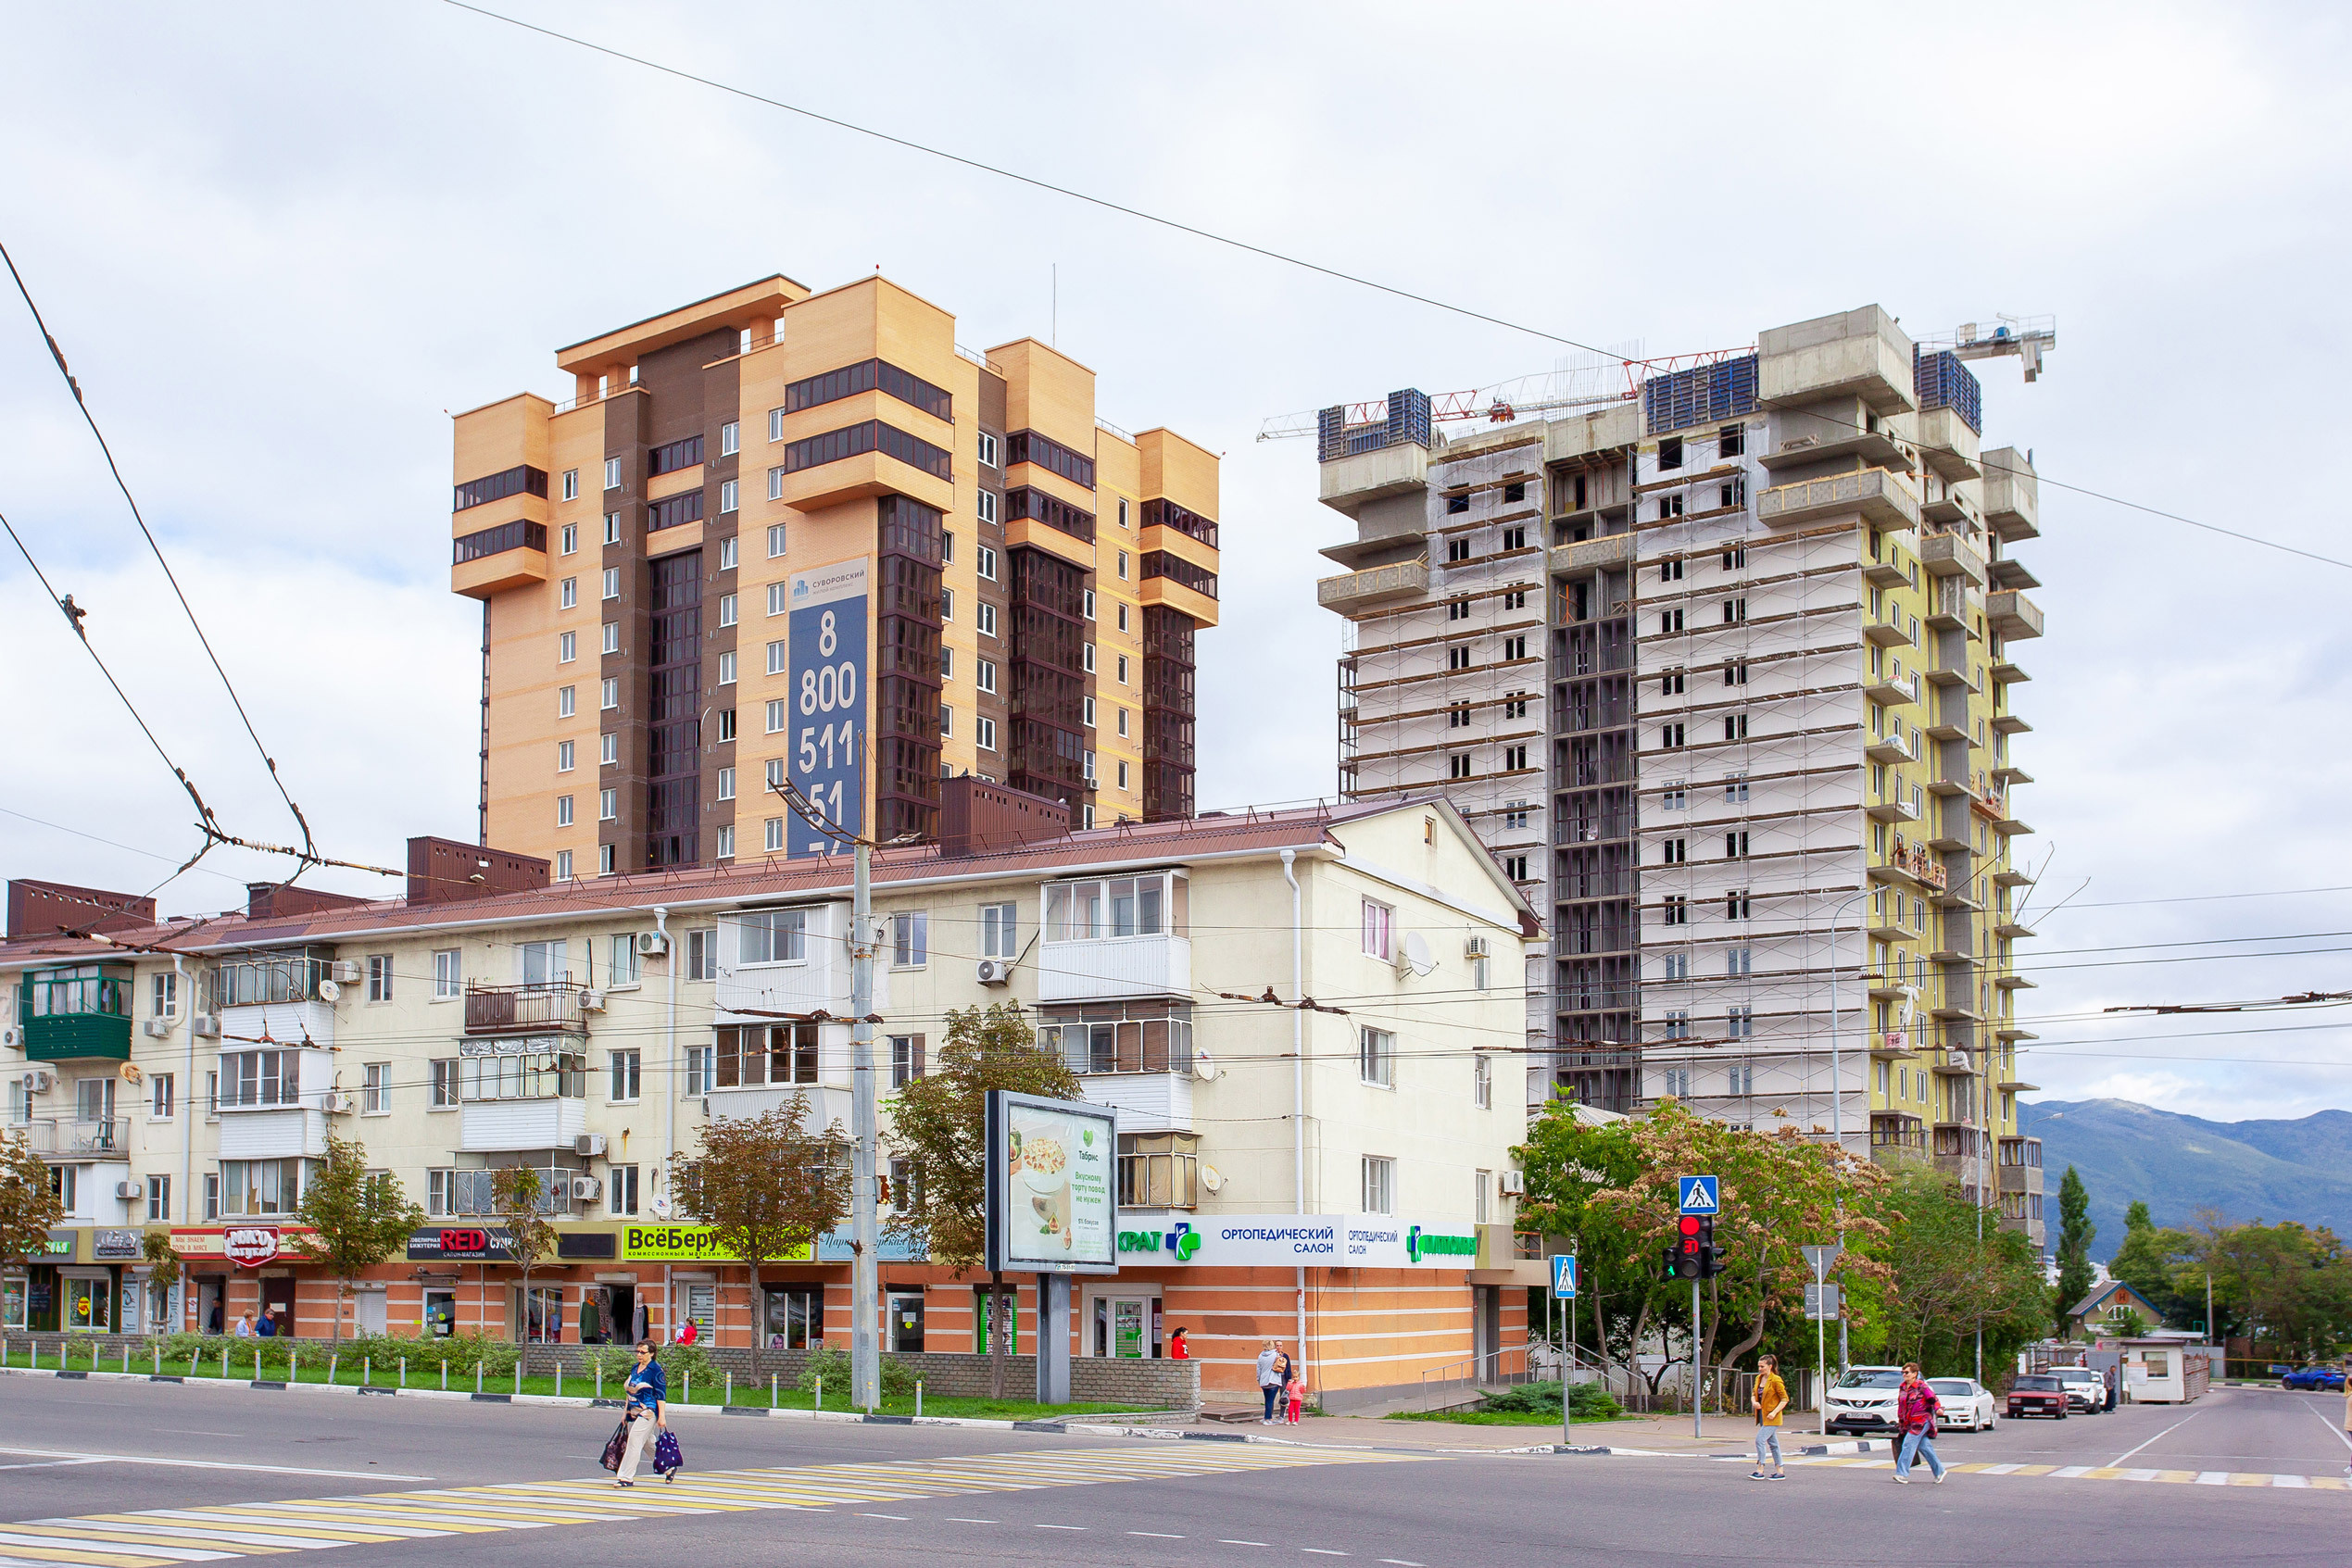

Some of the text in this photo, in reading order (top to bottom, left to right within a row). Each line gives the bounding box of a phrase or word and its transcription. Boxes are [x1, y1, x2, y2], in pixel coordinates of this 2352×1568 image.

[812, 569, 865, 588] СУВОРОВСКИЙ
[819, 609, 837, 658] 8
[799, 660, 857, 717] 800
[799, 720, 853, 774] 511
[807, 780, 843, 831] 51
[1078, 1150, 1099, 1162] Табрис
[1075, 1172, 1102, 1184] Вкусному
[1072, 1184, 1106, 1195] торту повод
[1084, 1197, 1101, 1205] нужен
[440, 1229, 485, 1250] RED
[628, 1228, 719, 1252] ВсёБеру
[1221, 1226, 1334, 1241] ОРТОПЕДИЧЕСКИЙ
[1348, 1230, 1399, 1244] ОРТОПЕДИЧЕСКИЙ
[1293, 1243, 1334, 1253] САЛОН
[1348, 1245, 1367, 1255] САЛОН
